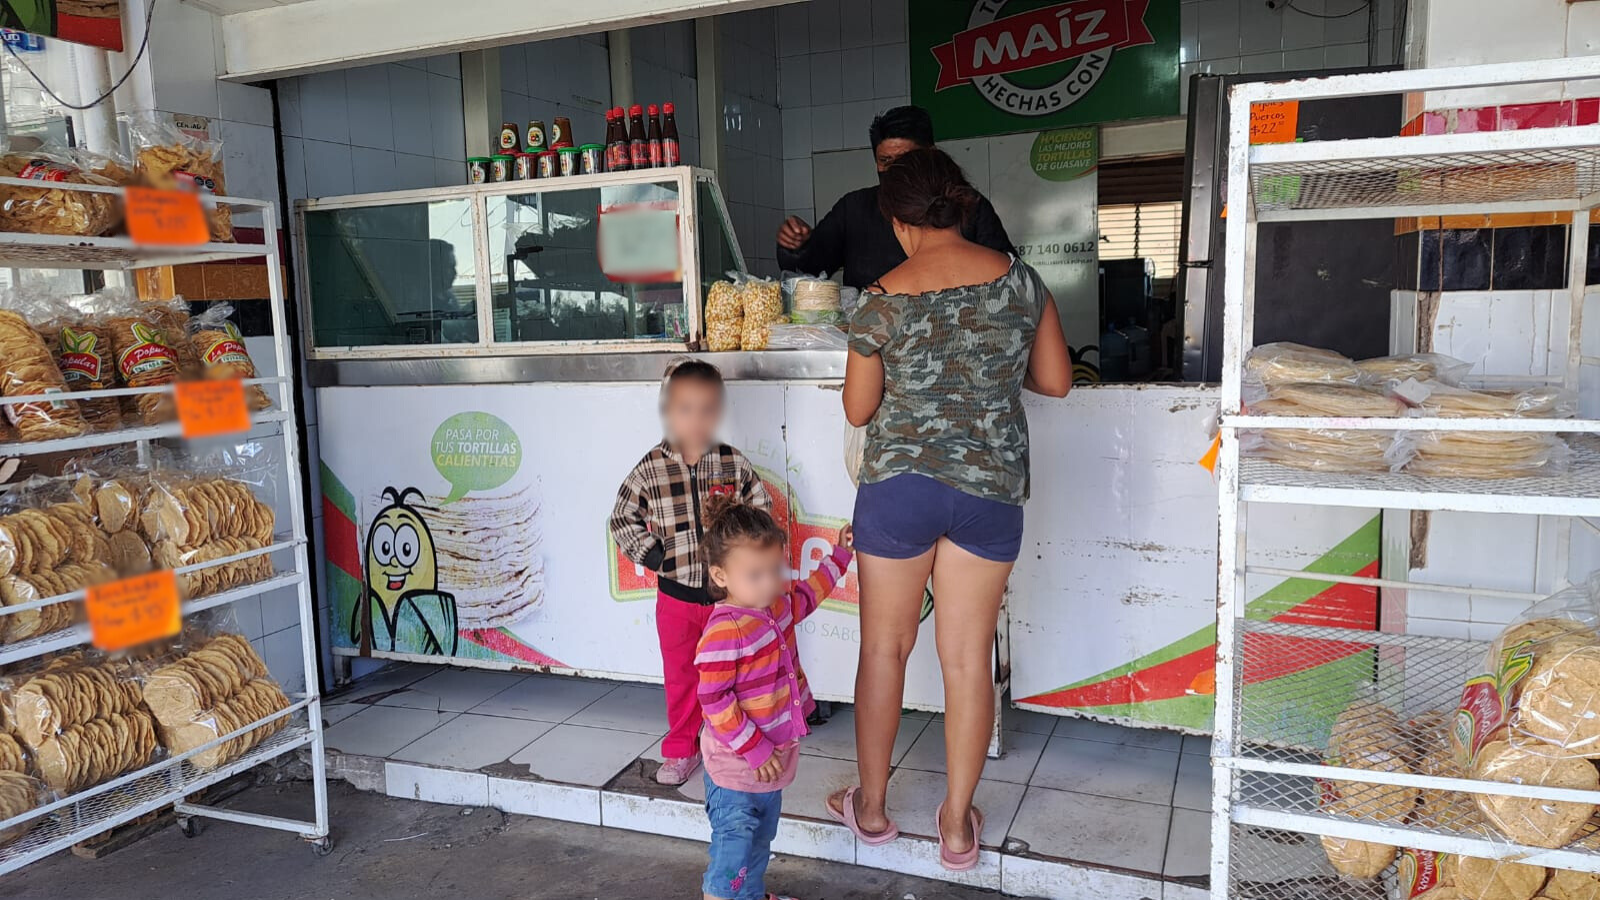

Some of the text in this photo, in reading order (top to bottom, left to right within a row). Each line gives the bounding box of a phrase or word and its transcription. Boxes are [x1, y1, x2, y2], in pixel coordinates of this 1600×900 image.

[972, 8, 1110, 69] MAÍZ
[982, 53, 1105, 111] HECHAS CON
[1250, 112, 1285, 121] Puercos
[1041, 131, 1092, 143] HACIENDO
[1039, 141, 1091, 152] LAS MEJORES
[1038, 150, 1092, 162] TORTILLAS
[1036, 159, 1091, 171] DE GUASAVE
[1037, 243, 1060, 255] 140
[1063, 241, 1094, 253] 0612
[446, 428, 500, 440] PASA POR
[435, 441, 517, 454] TUS TORTILLAS
[436, 455, 516, 467] CALIENTITAS
